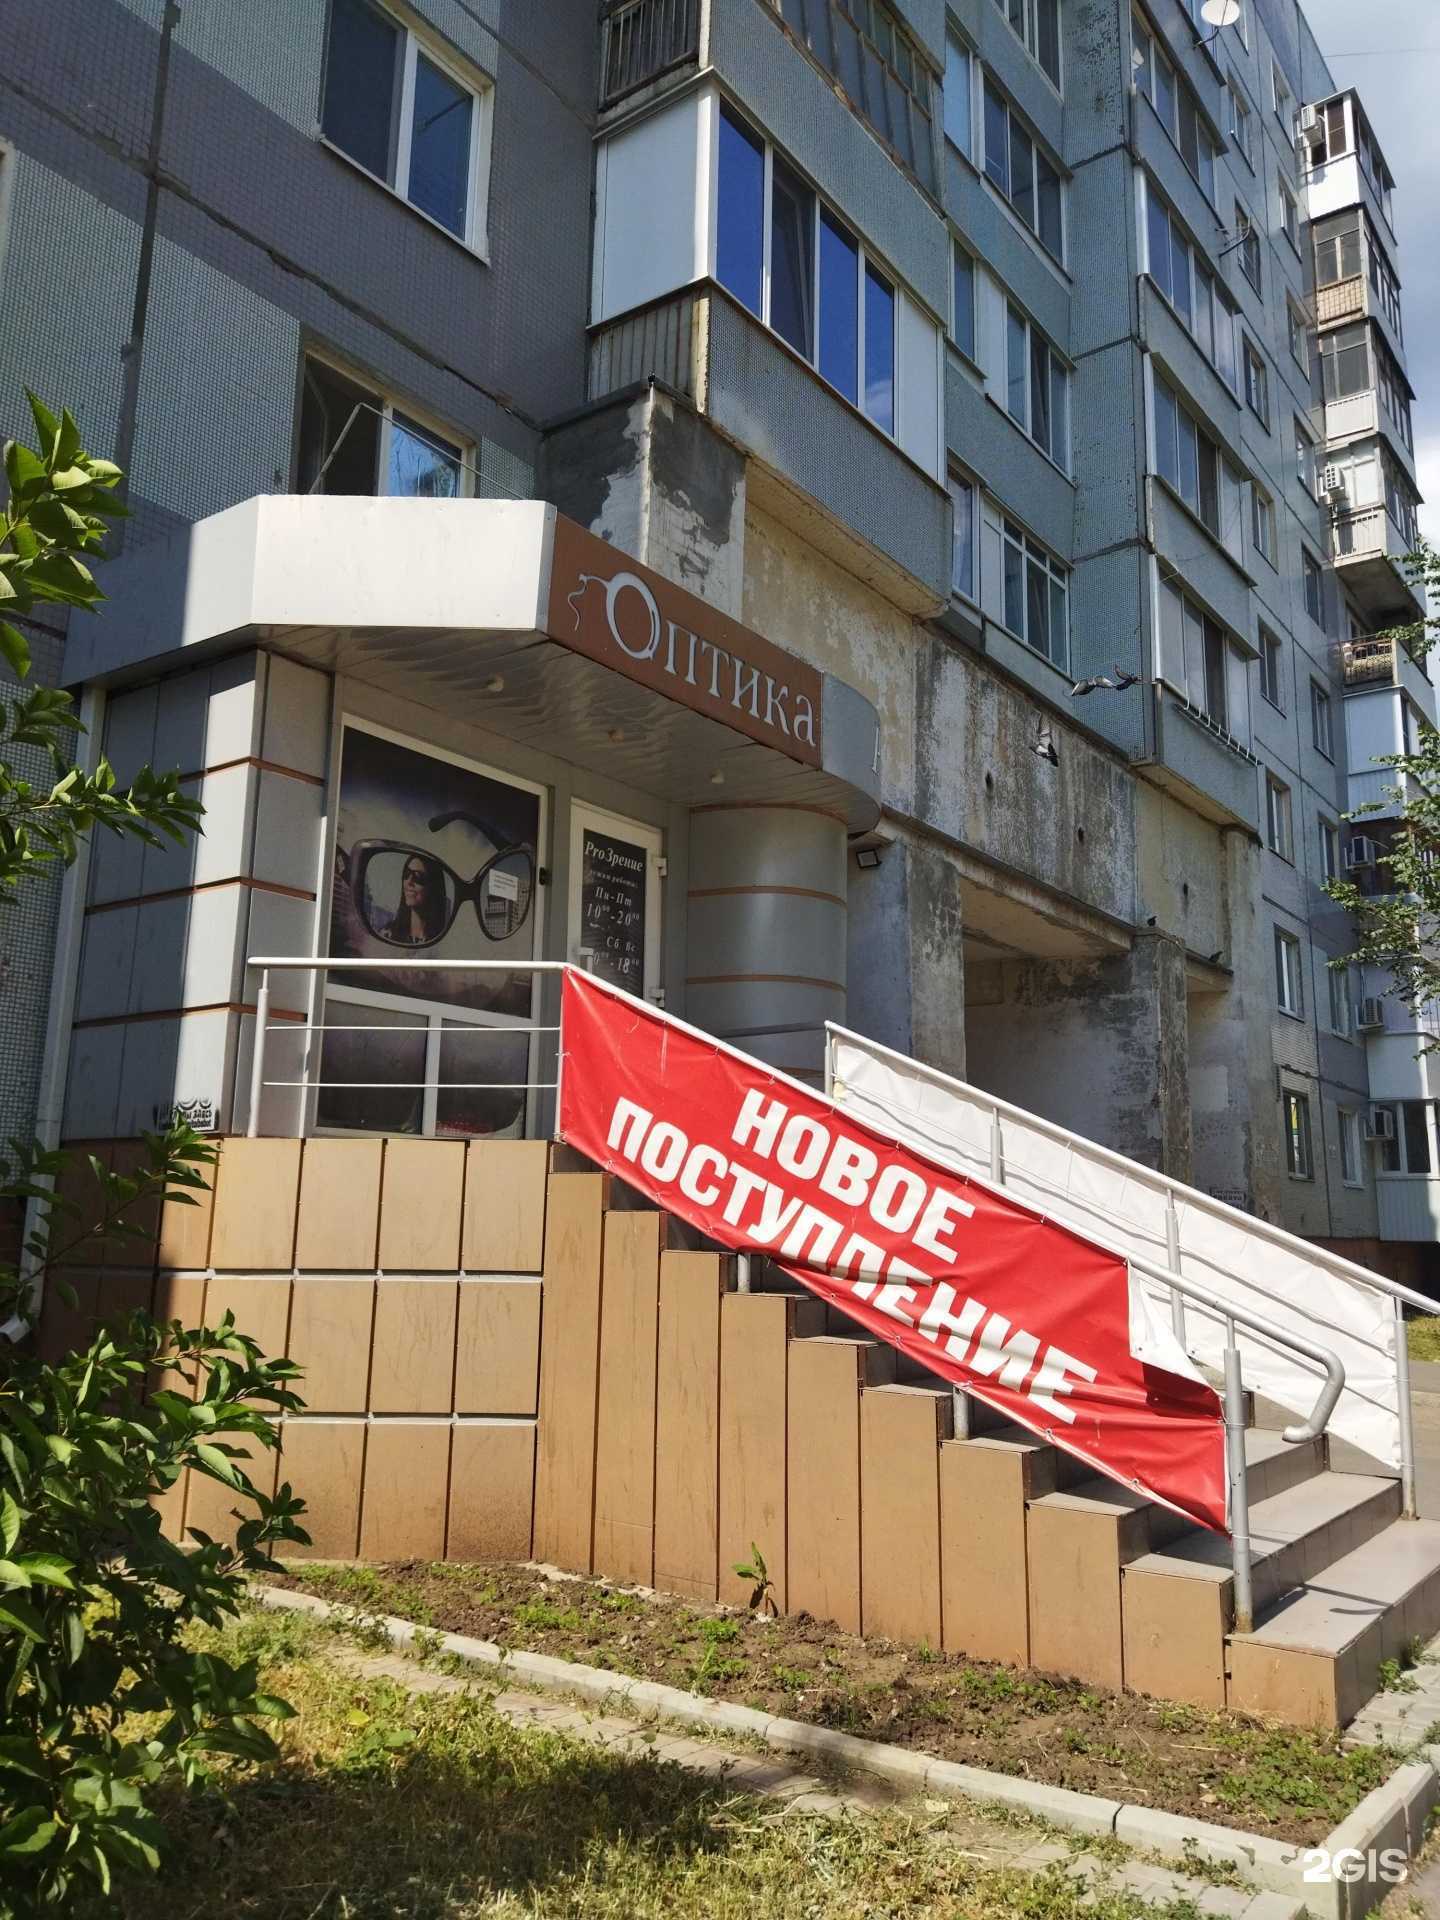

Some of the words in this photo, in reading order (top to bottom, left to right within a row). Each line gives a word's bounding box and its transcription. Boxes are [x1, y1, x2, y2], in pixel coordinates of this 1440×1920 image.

[578, 572, 817, 747] Оптика
[585, 841, 643, 872] ProЗрение
[606, 1096, 1098, 1425] ПОСТУПЛЕНИЕ
[731, 1087, 976, 1264] НОВОЕ
